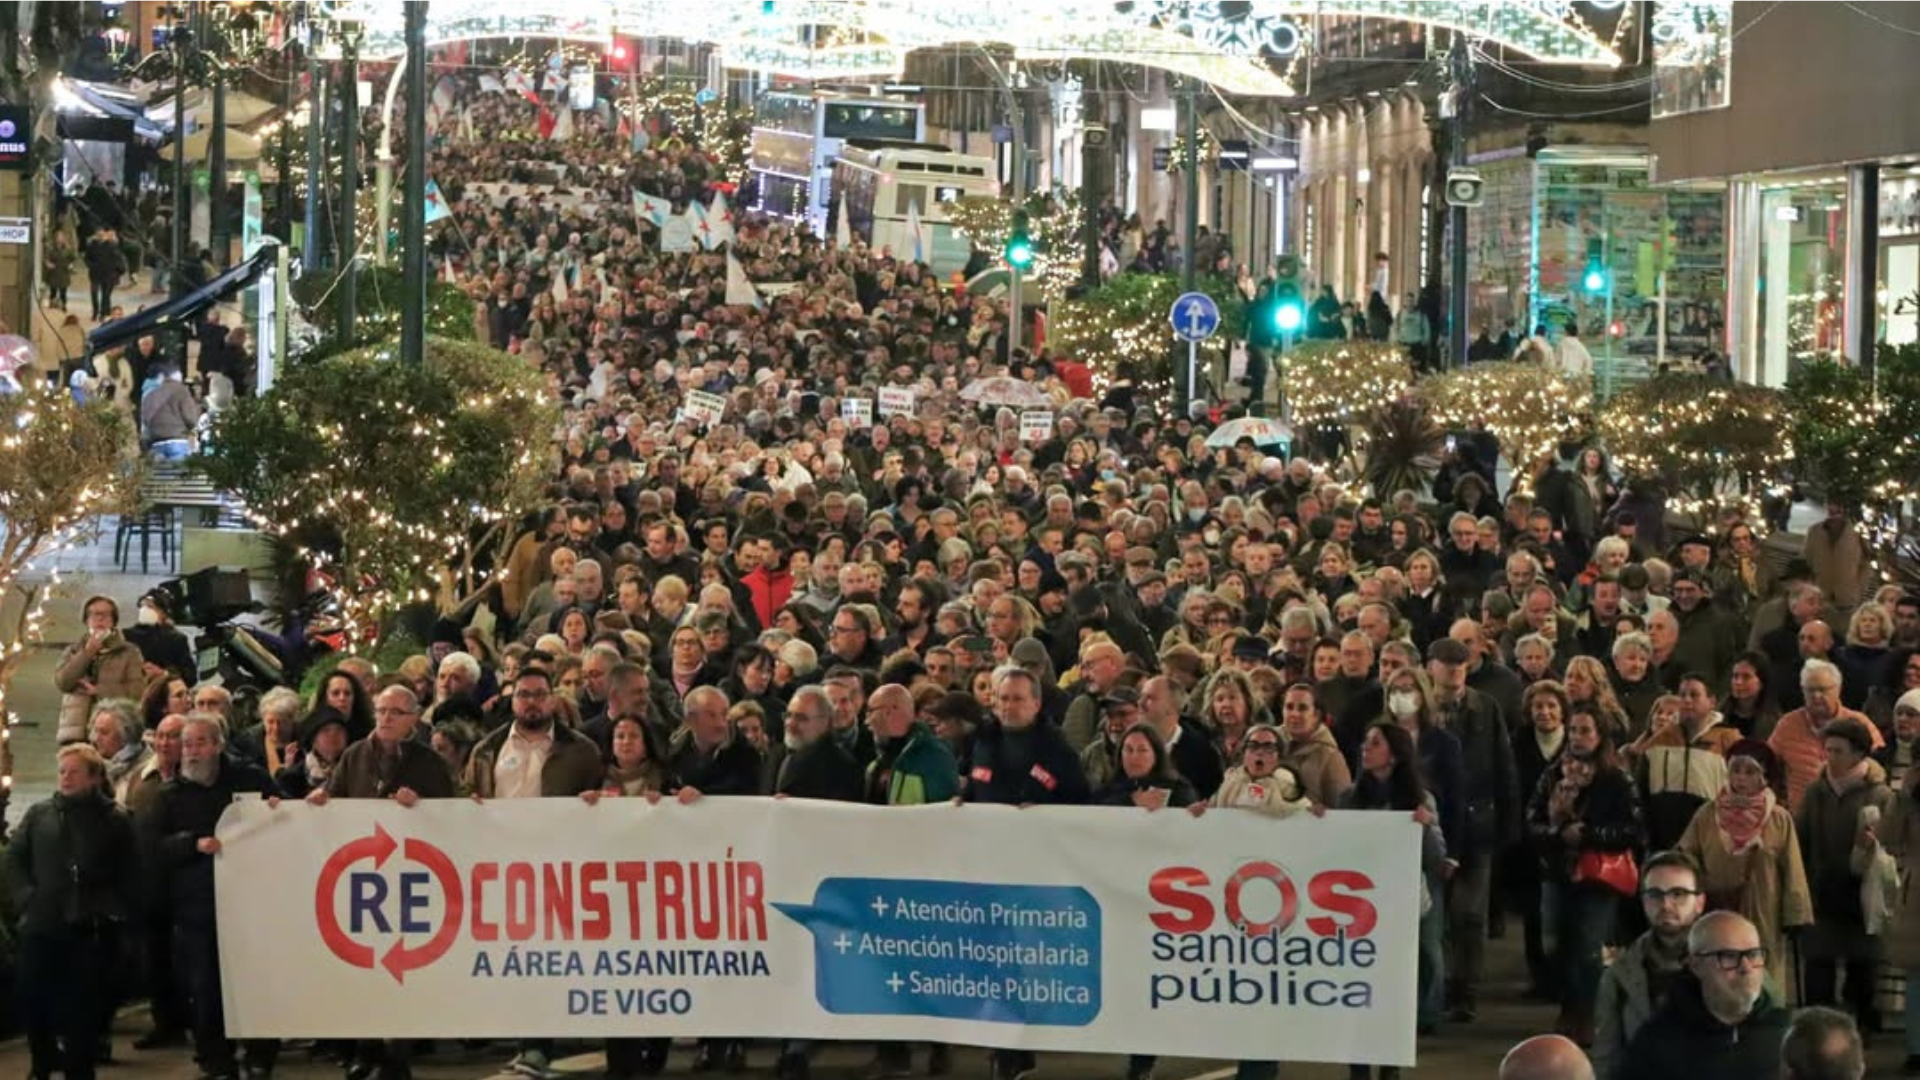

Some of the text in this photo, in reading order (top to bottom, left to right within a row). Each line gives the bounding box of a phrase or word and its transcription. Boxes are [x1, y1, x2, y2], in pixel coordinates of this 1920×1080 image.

[349, 847, 768, 941] RE CONSTRUÍR
[1148, 861, 1378, 939] SOS
[895, 898, 985, 924] Atención
[991, 903, 1087, 928] Primaria
[472, 946, 770, 977] A ÁREA ASANITARIA
[858, 933, 953, 959] Atención
[958, 938, 1090, 968] Hospitalaria
[1152, 925, 1377, 968] sanidade
[568, 988, 692, 1016] DE VIGO
[909, 971, 1001, 999] Sanidade
[1006, 977, 1090, 1004] Pública
[1151, 968, 1372, 1009] pública
